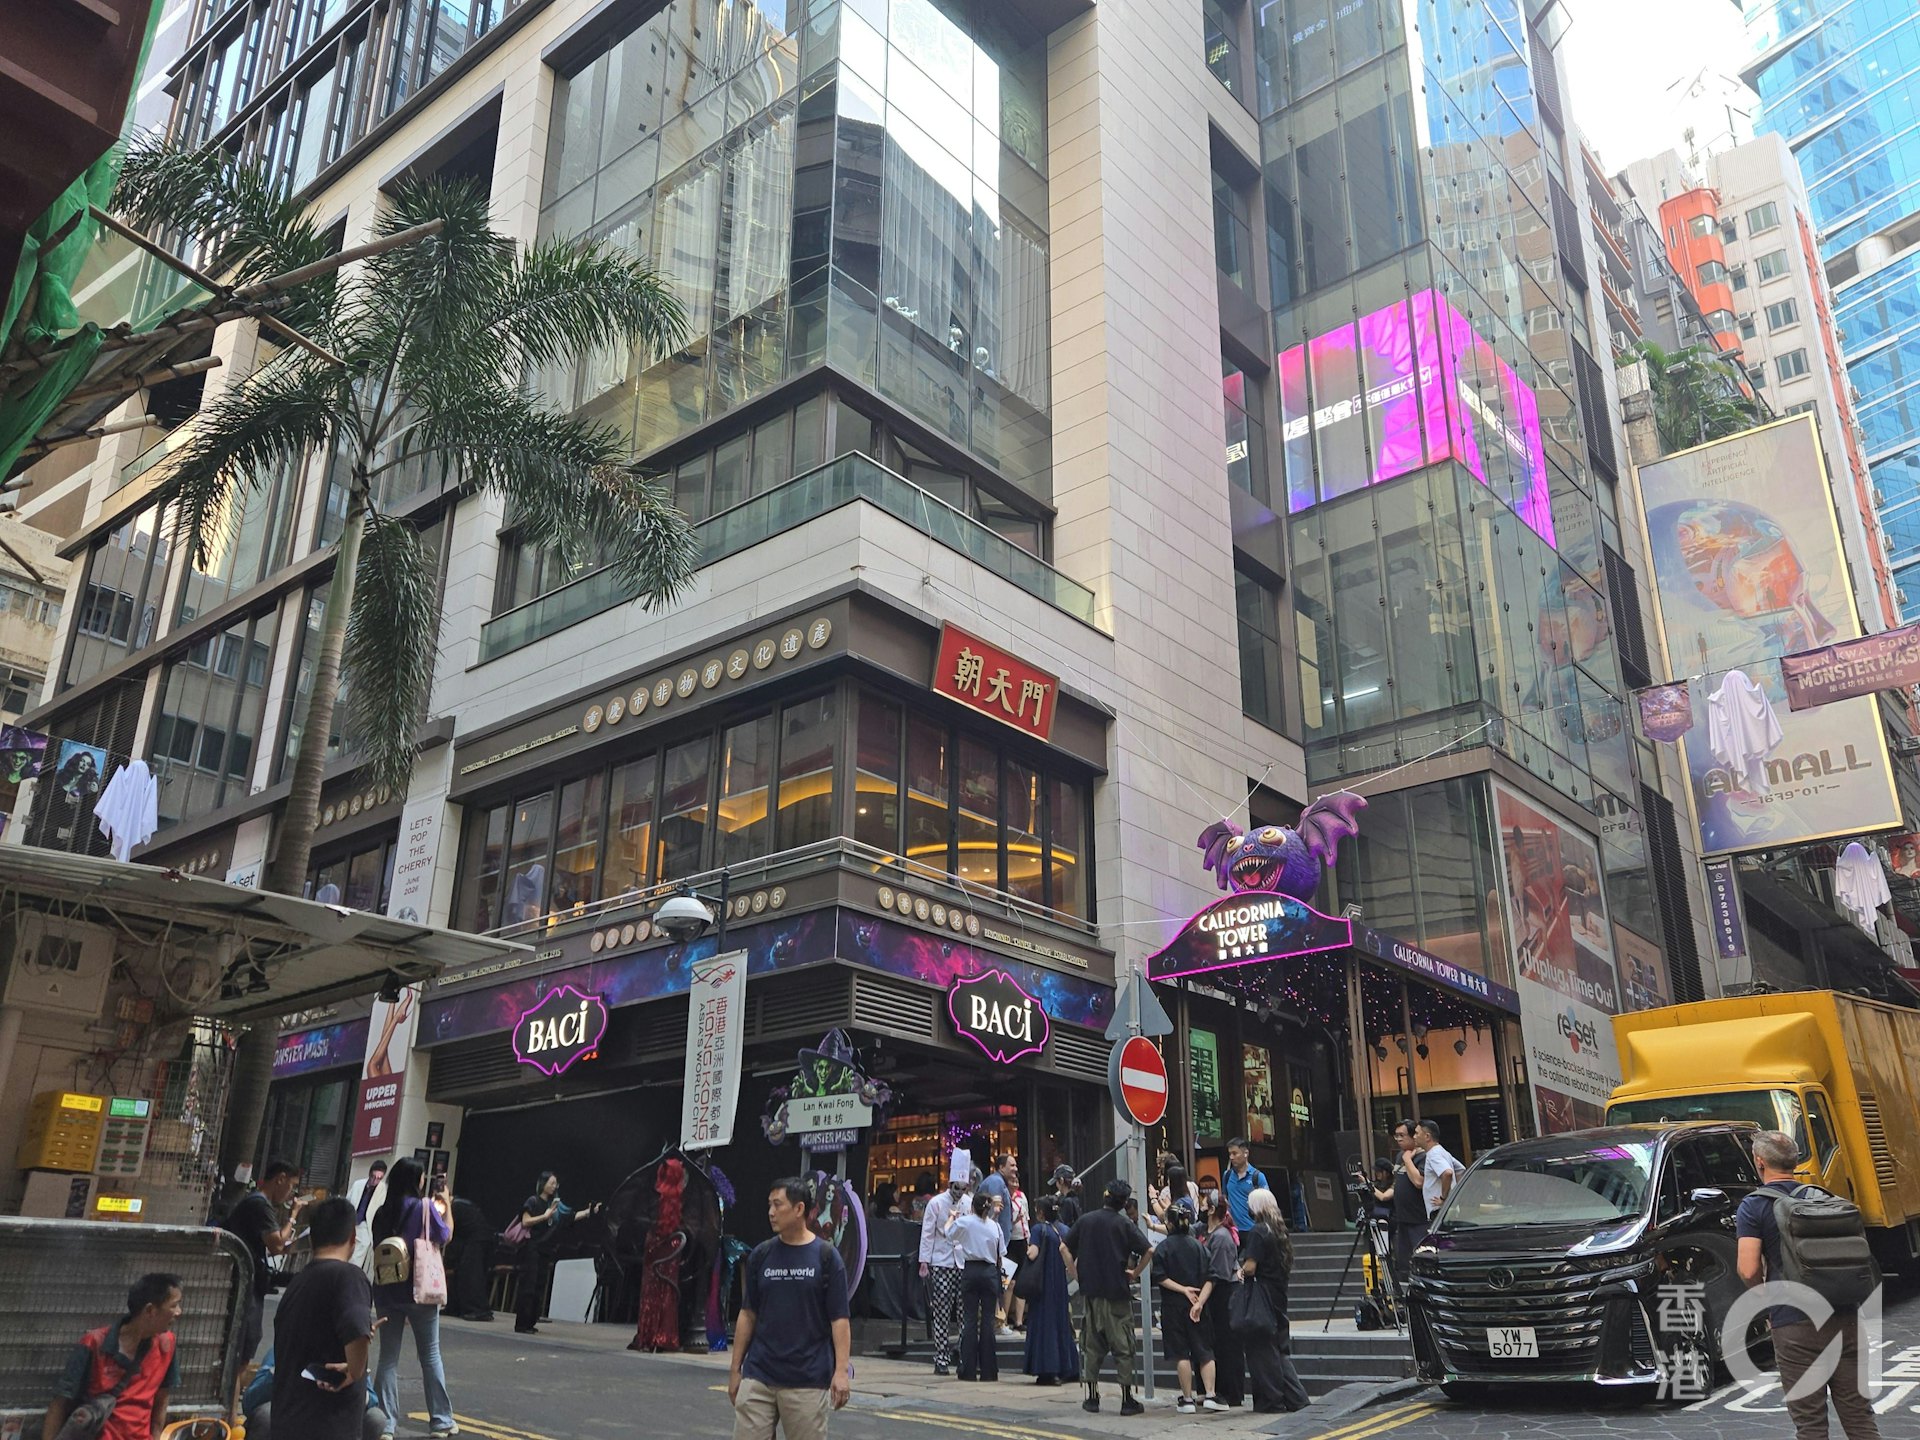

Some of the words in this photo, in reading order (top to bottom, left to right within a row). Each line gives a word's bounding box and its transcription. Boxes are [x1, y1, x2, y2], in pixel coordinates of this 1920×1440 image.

[1702, 466, 1756, 488] INTELLIGENCE
[1707, 460, 1748, 477] ARTIFICIAL
[1803, 655, 1830, 670] LAN
[1878, 634, 1918, 651] FONG
[586, 622, 828, 730] 重慶市非物質文化遺產
[1797, 655, 1877, 690] MONSTER
[952, 646, 1046, 728] 朝天門
[409, 815, 433, 831] LET'S
[410, 830, 428, 844] POP
[409, 844, 426, 857] THE
[397, 855, 433, 875] CHERRY
[1199, 900, 1285, 932] CALIFORNIA
[1217, 924, 1268, 948] TOWER
[1393, 943, 1435, 974] CALIFORNIA
[1435, 960, 1459, 983] TOWER
[1522, 946, 1569, 992] Unplug,
[1568, 967, 1594, 1000] Time
[1595, 984, 1614, 1010] Out
[697, 1003, 706, 1048] ASIA'S
[702, 999, 716, 1067] HONG
[303, 1038, 329, 1061] MASH
[694, 1051, 703, 1104] WORLD
[709, 996, 728, 1140] 香港亞洲國際都會
[1537, 1063, 1548, 1078] the
[1549, 1069, 1570, 1086] optimal
[1572, 1076, 1590, 1093] reboot
[1591, 1085, 1601, 1097] and
[1538, 1049, 1585, 1076] science-backed
[1586, 1067, 1609, 1087] recovey
[366, 1083, 398, 1101] UPPER
[698, 1071, 711, 1141] KONG
[803, 1102, 816, 1112] Lan
[818, 1099, 835, 1110] Kwai
[836, 1098, 854, 1109] Fong
[691, 1106, 700, 1141] CITY
[812, 1113, 843, 1127] 蘭桂坊
[801, 1130, 835, 1146] MONSTER
[835, 1129, 857, 1144] MASH
[764, 1267, 789, 1278] Game
[789, 1266, 815, 1277] world
[1493, 1342, 1532, 1356] 5077
[1501, 1329, 1521, 1343] YW
